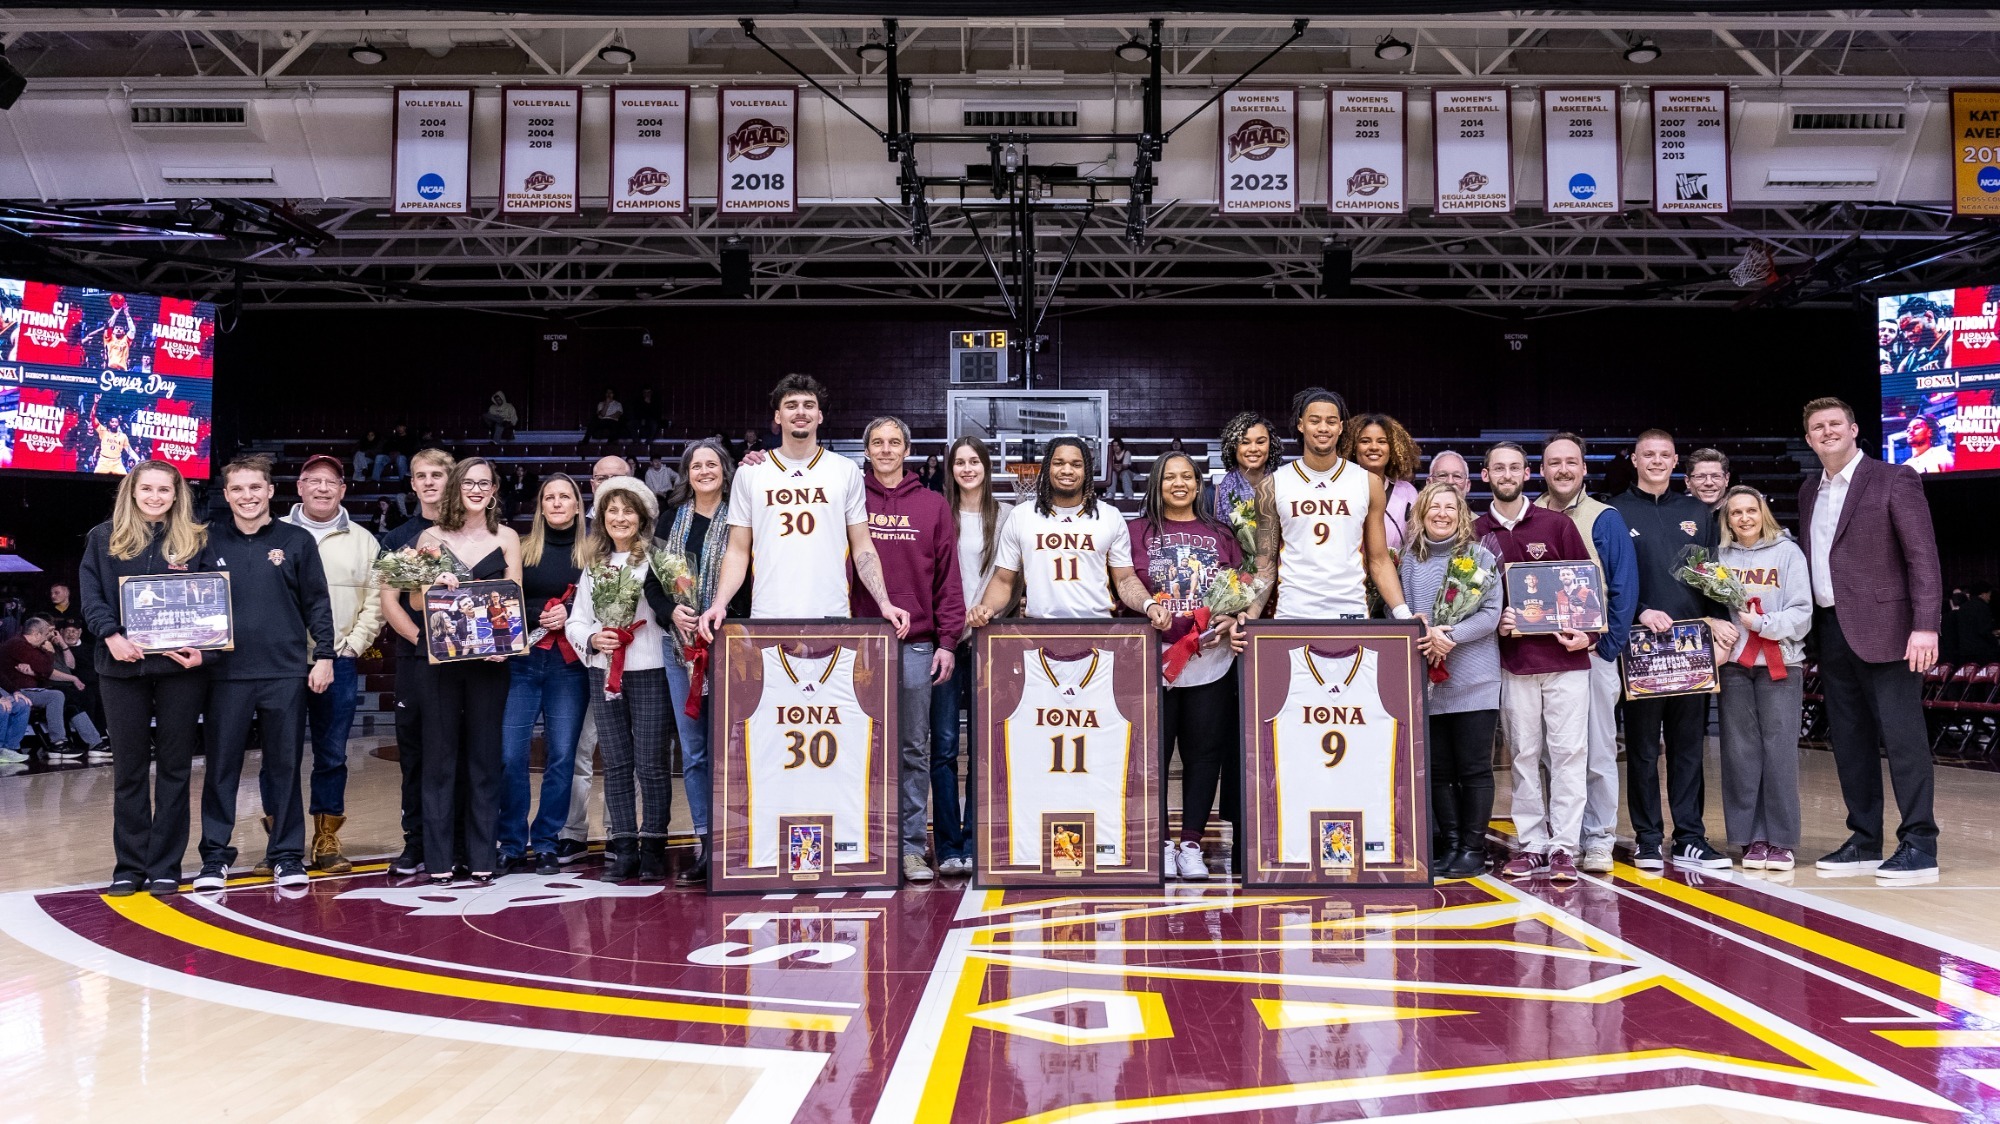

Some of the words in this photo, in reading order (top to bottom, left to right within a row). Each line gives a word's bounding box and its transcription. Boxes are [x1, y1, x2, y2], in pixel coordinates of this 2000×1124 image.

[1238, 95, 1280, 103] WOMEN'S
[420, 119, 446, 127] 2004
[1460, 119, 1484, 127] 2014
[1569, 119, 1593, 127] 2016
[1660, 119, 1685, 127] 2007
[1697, 119, 1720, 127] 2014
[421, 130, 444, 138] 2018
[1460, 130, 1485, 138] 2023
[1569, 130, 1594, 138] 2023
[1660, 130, 1686, 138] 2008
[727, 126, 790, 163] MAAC
[1228, 126, 1290, 163] MAAC
[1661, 141, 1685, 149] 2010
[1662, 152, 1685, 160] 2013
[420, 185, 445, 194] NCAA
[524, 174, 556, 192] MAAC
[628, 172, 670, 196] MAAC
[731, 173, 785, 190] 2018
[1230, 174, 1288, 191] 2023
[1347, 173, 1388, 197] MAAC
[1458, 174, 1488, 193] MAAC
[1571, 185, 1597, 194] NCAA
[616, 200, 681, 208] CHAMPIONS
[726, 200, 790, 208] CHAMPIONS
[1227, 201, 1291, 209] CHAMPIONS
[1335, 201, 1400, 209] CHAMPIONS
[1442, 201, 1507, 209] CHAMPIONS
[1553, 201, 1614, 209] APPEARANCES
[53, 301, 70, 317] CJ
[1982, 302, 1998, 316] CJ
[2, 307, 68, 330] ANTHONY
[169, 313, 202, 331] TOBY
[1936, 315, 1998, 332] ANTHONY
[152, 323, 200, 343] HARRIS
[551, 341, 559, 351] 8
[1510, 341, 1522, 350] 10
[100, 370, 143, 394] Senior
[145, 374, 177, 399] Day
[1916, 375, 1955, 389] IONA
[19, 402, 65, 422] LAMIN
[137, 410, 199, 430] KESHAWN
[5, 416, 64, 435] SABALLY
[131, 423, 198, 444] WILLIAMS
[765, 487, 829, 506] IONA
[1290, 500, 1351, 518] IONA
[779, 511, 816, 537] 30
[868, 513, 911, 527] IONA
[1035, 533, 1096, 551] IONA
[1146, 532, 1218, 552] SENIOR
[1313, 522, 1330, 545] 9
[1053, 557, 1082, 581] 11
[776, 706, 842, 725] IONA
[1035, 708, 1100, 728] IONA
[1302, 706, 1366, 725] IONA
[783, 729, 838, 770] 30
[1048, 733, 1089, 774] 11
[1320, 730, 1347, 768] 9
